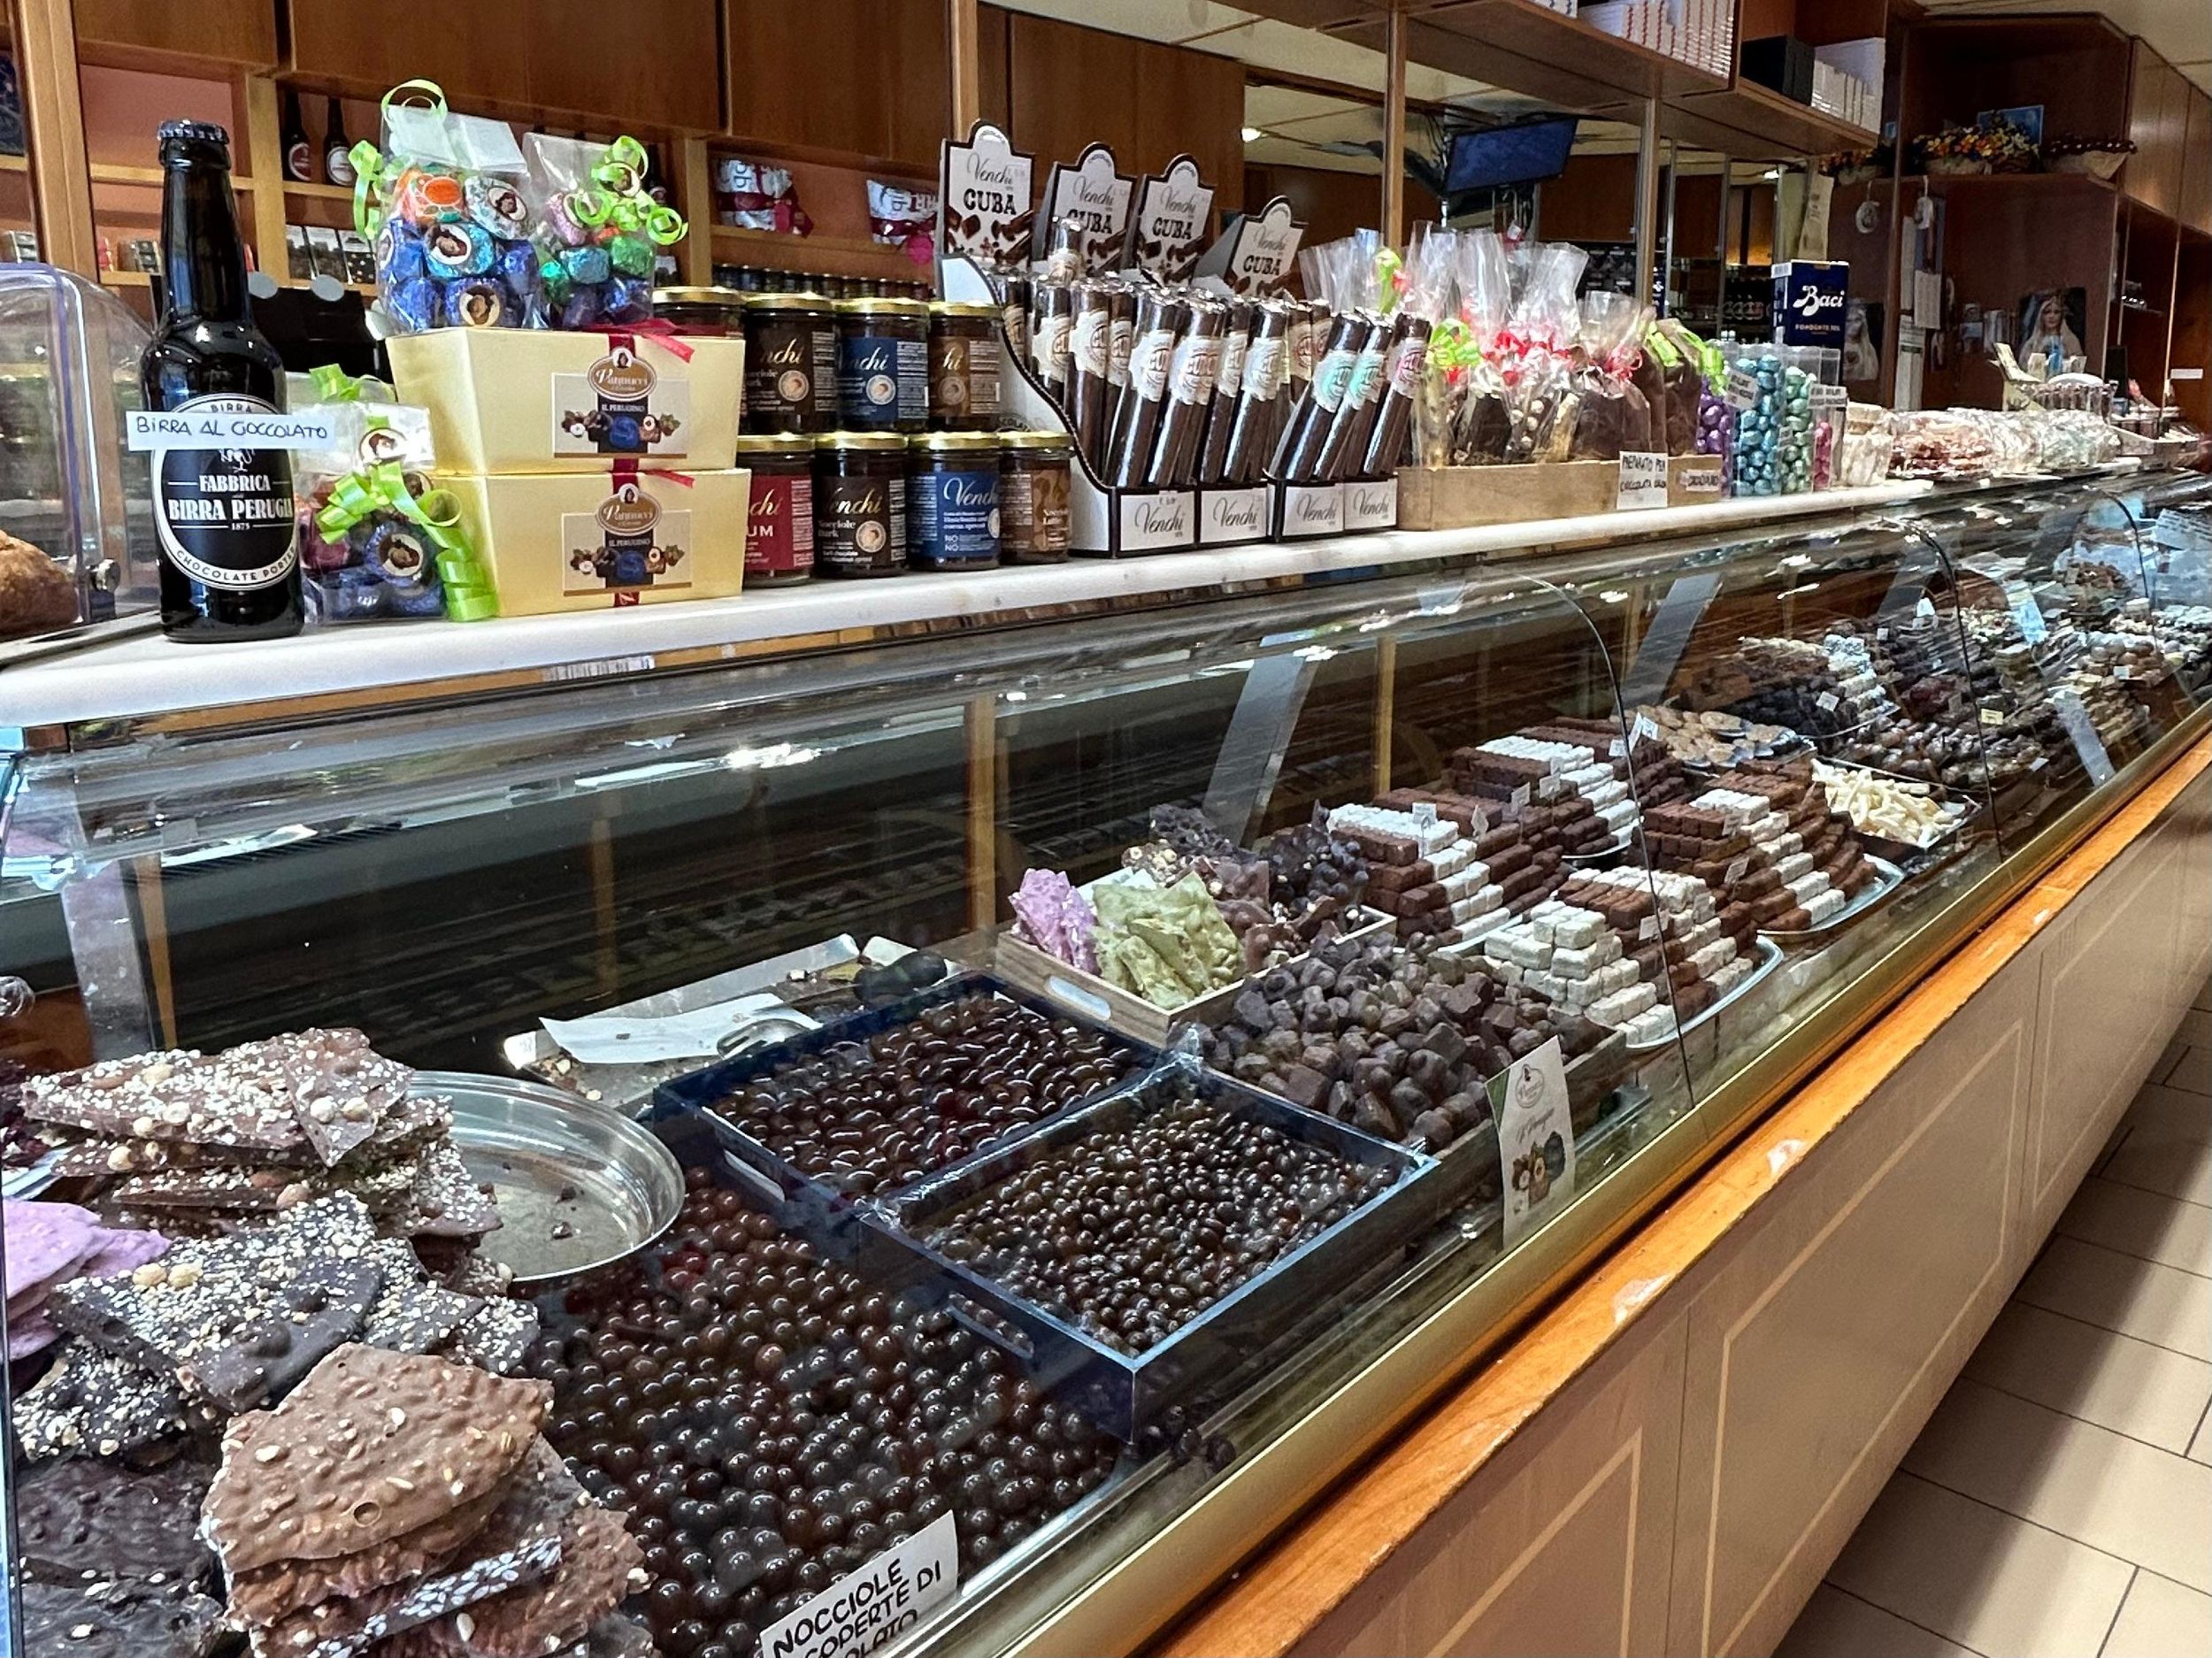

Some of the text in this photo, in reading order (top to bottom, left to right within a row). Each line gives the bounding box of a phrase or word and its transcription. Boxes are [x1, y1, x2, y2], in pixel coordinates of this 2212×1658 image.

[967, 152, 1013, 185] Venchi
[963, 188, 1017, 216] CUBA
[1072, 175, 1114, 205] Venchi
[1152, 217, 1192, 240] CUBA
[1243, 255, 1282, 276] CUBA
[1792, 285, 1846, 317] Baci
[211, 403, 252, 414] BIRRA
[135, 416, 192, 436] BIRRA
[200, 419, 226, 436] AL
[199, 474, 271, 493] FABBRICA
[168, 499, 227, 521] BIRRA
[1213, 496, 1258, 527] Venchi
[1297, 493, 1338, 522] Venchi
[1353, 487, 1390, 516] Venchi
[1134, 503, 1186, 534] Venchi
[176, 550, 257, 582] CHOCOLATE
[772, 1557, 903, 1658] NOCCIOLE
[804, 1559, 942, 1658] COPERTE DI
